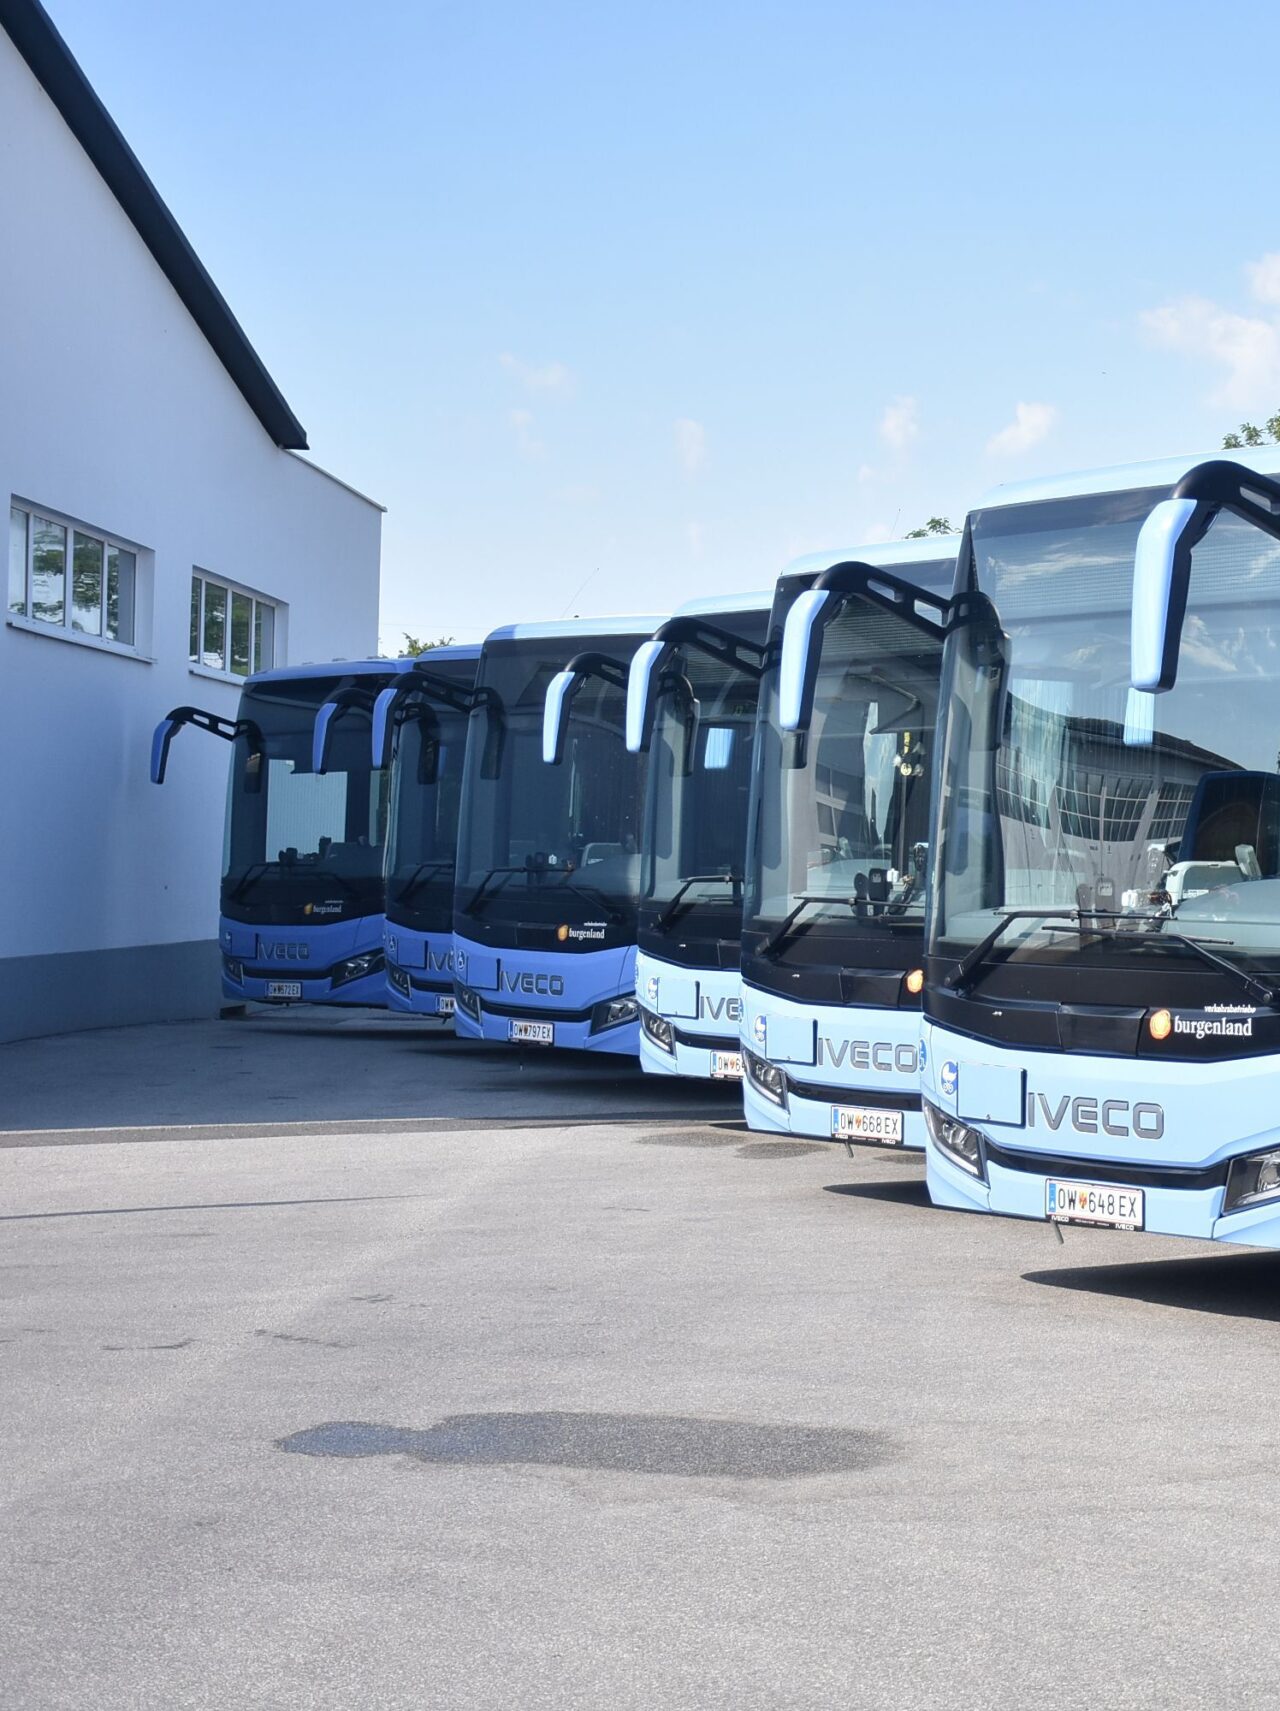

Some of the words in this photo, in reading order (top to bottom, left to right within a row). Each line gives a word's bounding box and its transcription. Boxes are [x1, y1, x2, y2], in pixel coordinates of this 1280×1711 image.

[569, 928, 605, 941] burgenland
[500, 969, 564, 996] IVECO
[1174, 1015, 1252, 1039] burgenland
[817, 1037, 918, 1073] IVECO
[841, 1113, 854, 1130] OW
[1028, 1092, 1165, 1140] IVECO
[1058, 1188, 1077, 1210] OW
[1051, 1215, 1069, 1223] IVECO
[1115, 1223, 1135, 1231] IVECO
